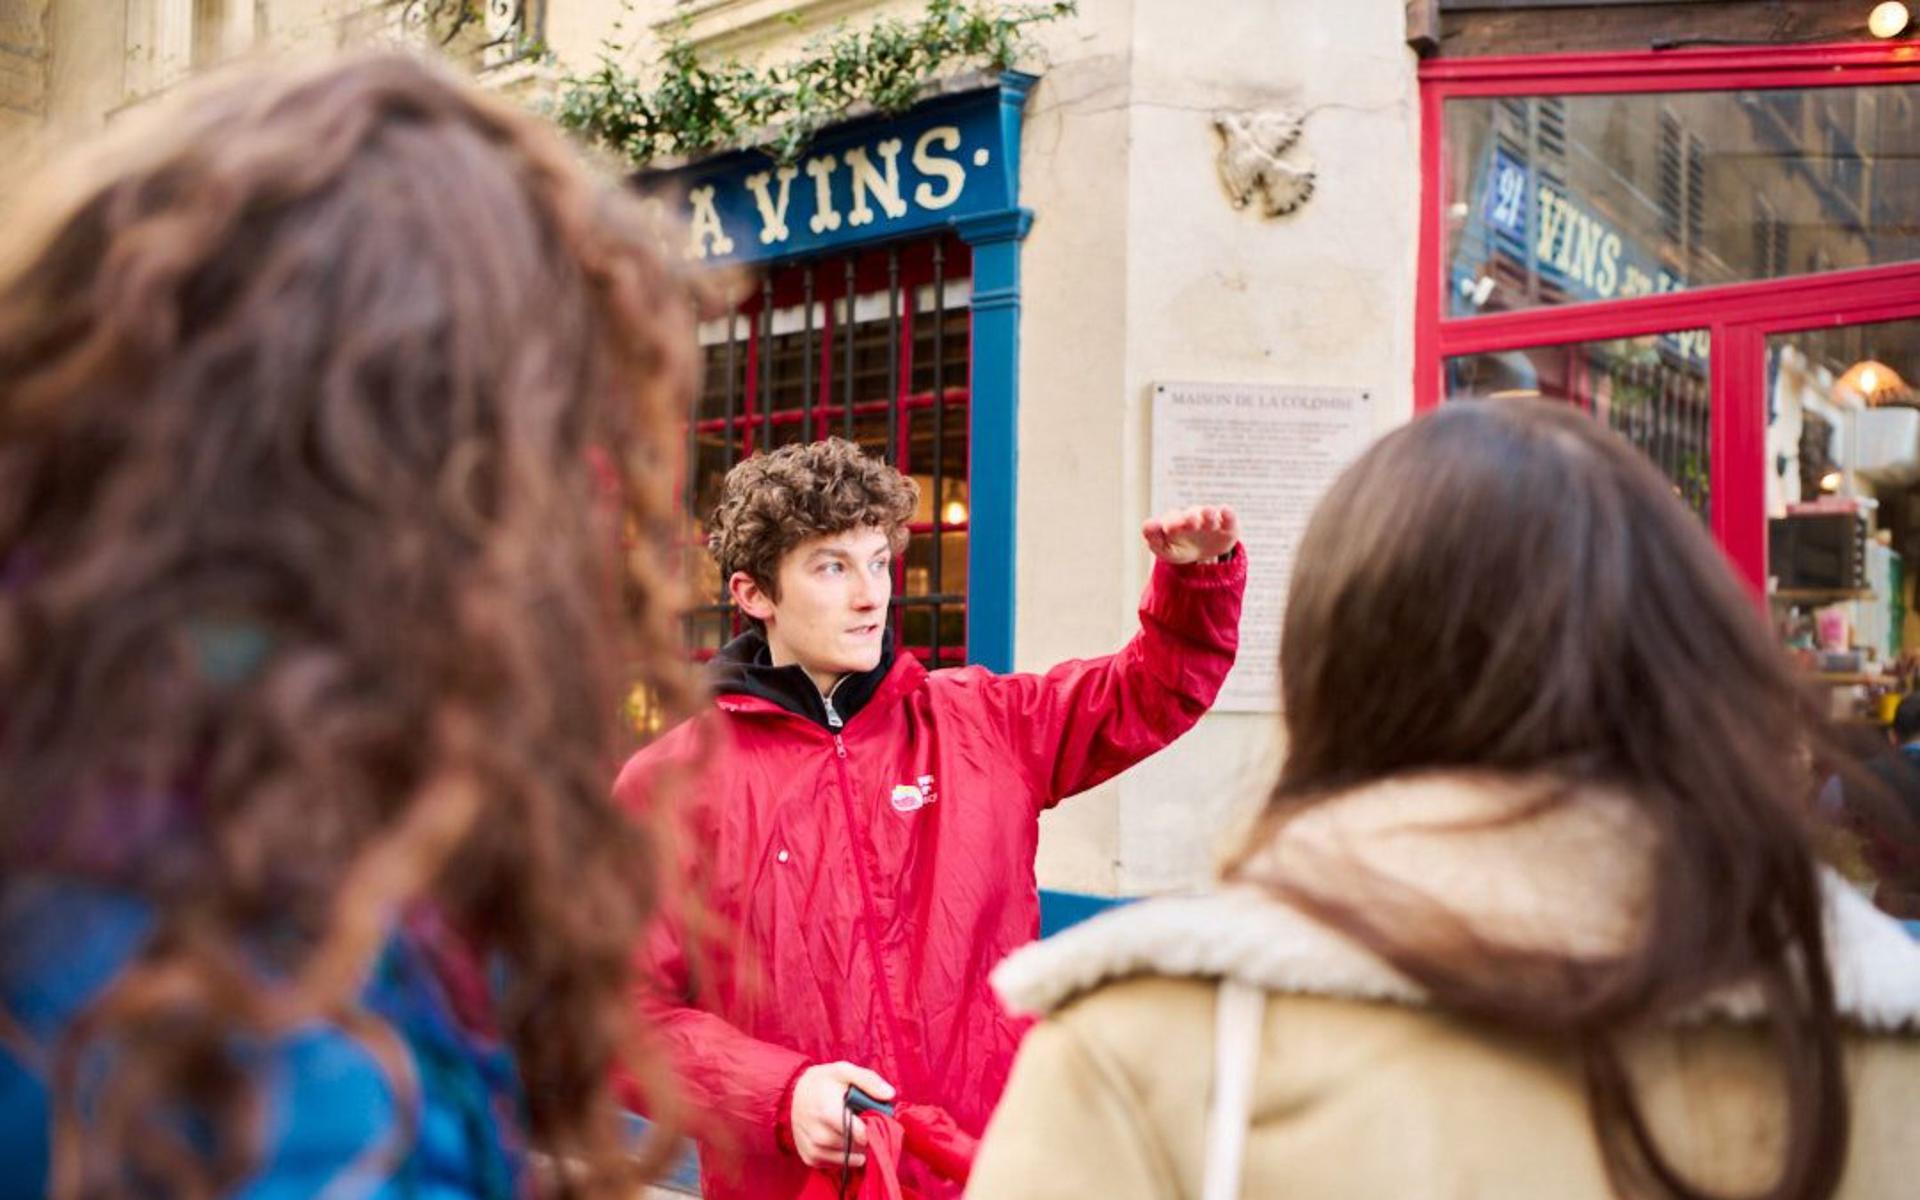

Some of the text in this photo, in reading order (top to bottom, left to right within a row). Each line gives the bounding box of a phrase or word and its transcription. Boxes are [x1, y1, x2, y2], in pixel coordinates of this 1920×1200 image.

[683, 185, 734, 259] A
[1537, 186, 1621, 297] VINS
[1172, 391, 1231, 406] MAISON
[1236, 393, 1252, 406] DE
[1258, 394, 1279, 408] LA
